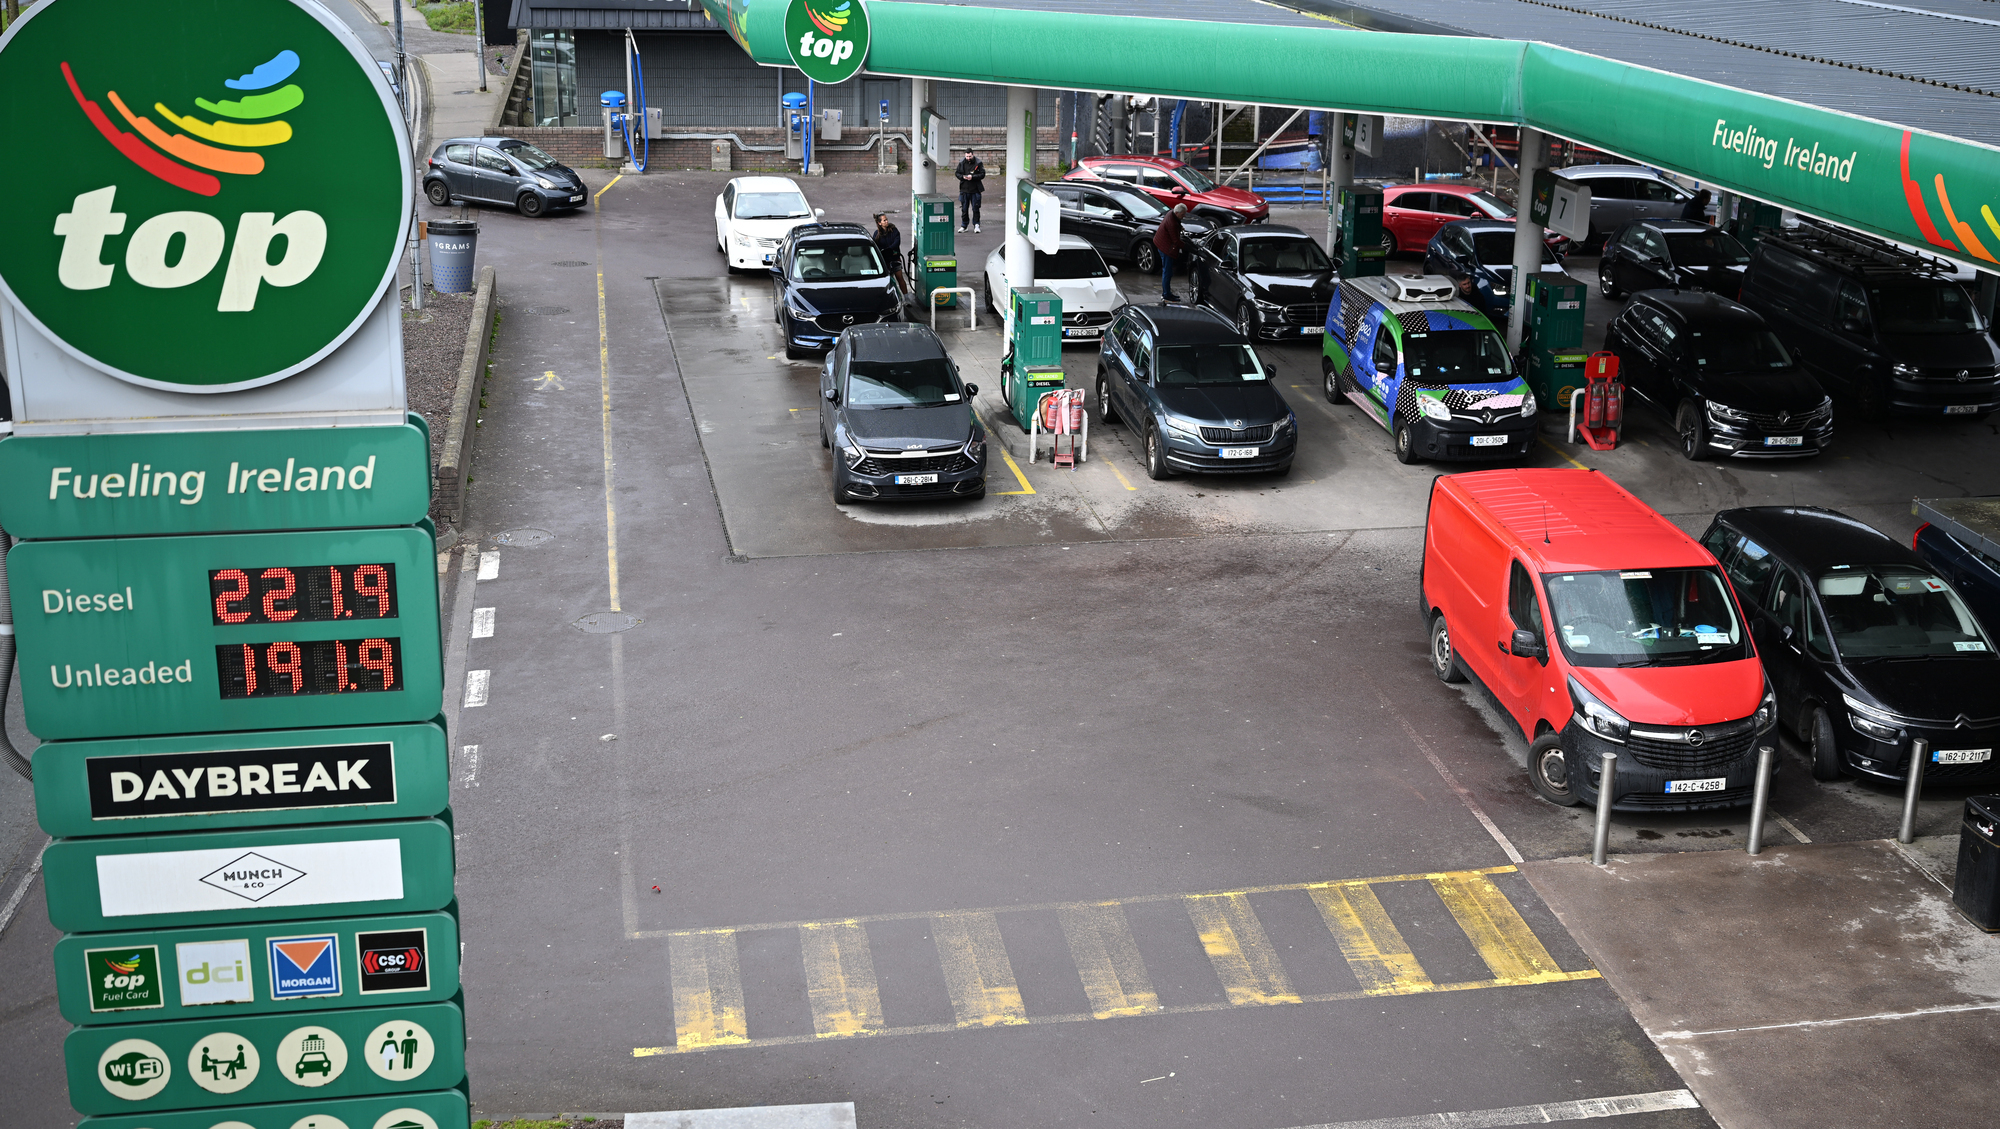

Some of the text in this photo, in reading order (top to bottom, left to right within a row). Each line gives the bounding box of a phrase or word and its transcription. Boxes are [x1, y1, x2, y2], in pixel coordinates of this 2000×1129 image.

[800, 31, 854, 65] top
[931, 131, 934, 150] 1
[1345, 126, 1354, 140] top
[1361, 123, 1366, 142] 5
[1712, 119, 1857, 183] Fueling Ireland
[1534, 199, 1547, 216] top
[1559, 196, 1568, 219] 7
[1018, 209, 1027, 228] top
[1034, 209, 1040, 233] 3
[53, 185, 328, 312] top
[434, 241, 470, 250] 9GRAMS
[49, 455, 377, 505] Fueling Ireland
[903, 476, 933, 484] 261-C-2814
[42, 564, 391, 623] Diesel 221.9
[50, 638, 394, 697] Unleaded 191.9
[1945, 752, 1985, 761] 162-D-2117
[109, 759, 372, 803] DAYBREAK
[1675, 781, 1720, 792] 142-C-4258
[223, 868, 283, 882] MUNCH
[251, 881, 265, 889] CO
[378, 953, 405, 968] CSC
[103, 971, 146, 991] top
[186, 959, 244, 985] dci
[281, 975, 332, 989] MORGAN
[102, 989, 149, 1001] Fuel Card
